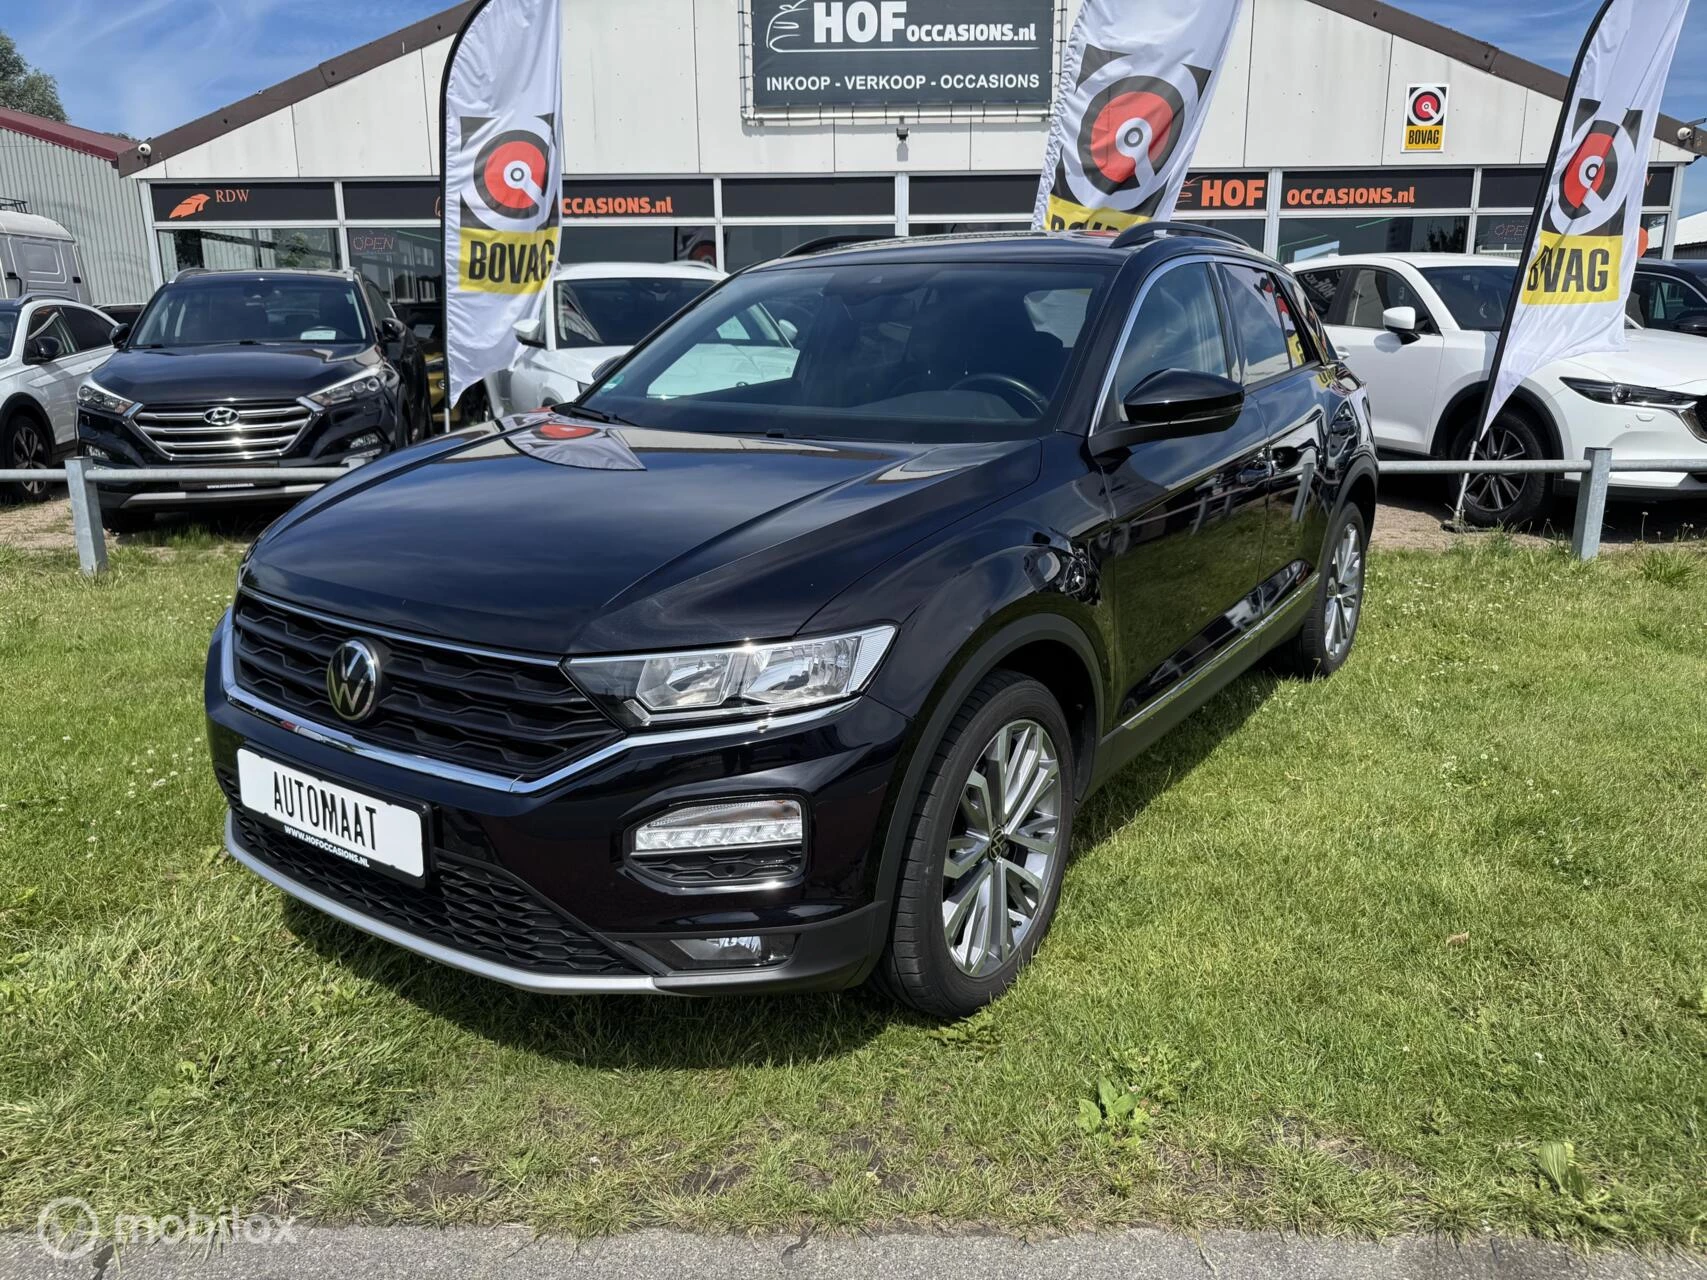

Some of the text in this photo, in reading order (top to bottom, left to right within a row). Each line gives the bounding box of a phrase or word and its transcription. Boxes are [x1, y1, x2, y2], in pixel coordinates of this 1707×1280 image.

[813, 1, 1037, 44] HOF OCCASIONS.nl
[766, 76, 831, 91] INKOOP
[844, 75, 926, 90] VERKOOP
[940, 74, 1040, 89] OCCASIONS
[1408, 129, 1440, 145] BOVAG
[215, 189, 250, 203] RDW
[1200, 179, 1415, 207] HOF OCCASIONS.nl
[562, 197, 673, 214] CCASIONS.nl
[352, 236, 395, 250] OPEN
[273, 771, 377, 851] AUTOMAAT
[284, 825, 370, 868] WWW.HOFOCCASIONS.NL
